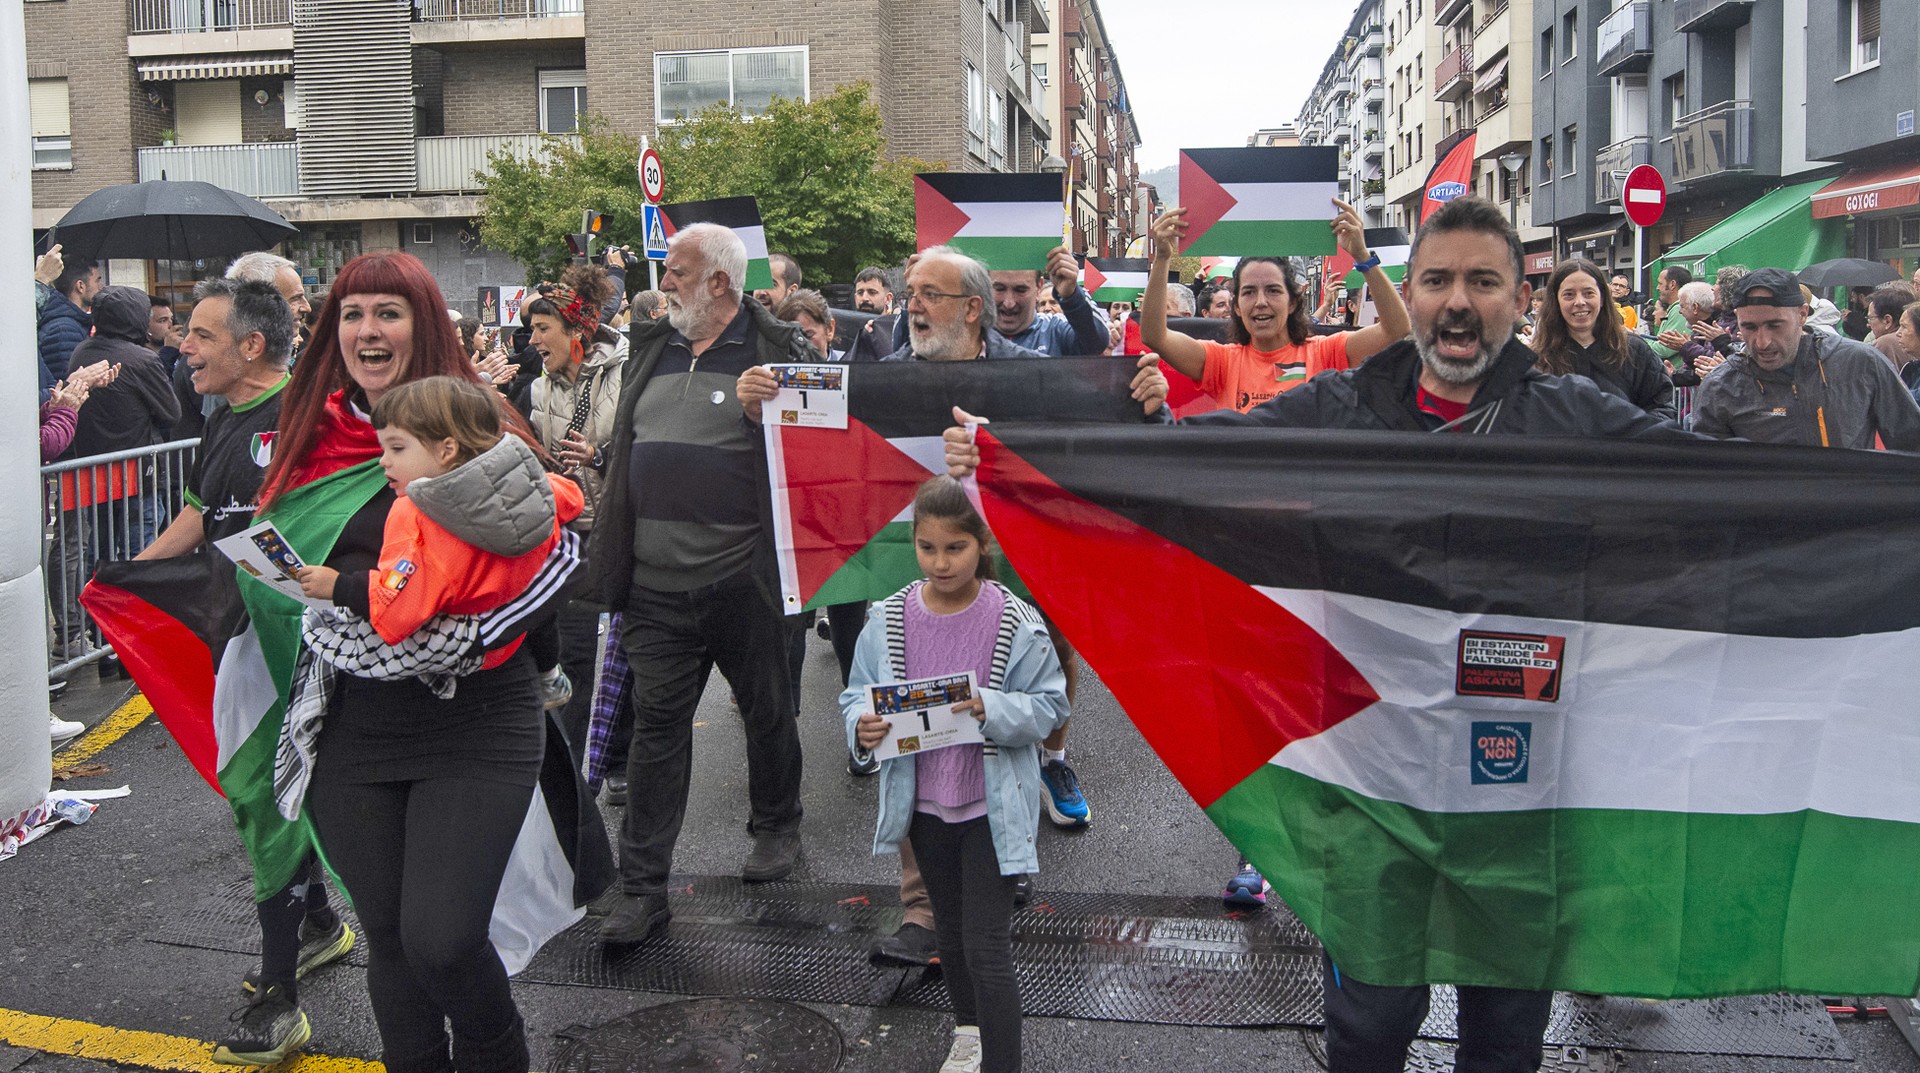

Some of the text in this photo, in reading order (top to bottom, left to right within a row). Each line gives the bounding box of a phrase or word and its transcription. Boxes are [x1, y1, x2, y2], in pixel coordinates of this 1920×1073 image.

[647, 167, 658, 185] 30
[1430, 185, 1463, 198] ARTIACH
[1846, 193, 1879, 211] GOXOGI
[799, 391, 808, 409] 1
[1466, 639, 1545, 652] BI ESTATUEN
[1466, 647, 1531, 658] IRTENBIDE
[1465, 655, 1553, 668] FALTSUARI EZ!
[1464, 669, 1520, 677] PALESTINA
[1464, 677, 1520, 686] ASKATU!
[917, 710, 931, 731] 1
[1478, 736, 1517, 748] OTAN
[1485, 747, 1517, 760] NON
